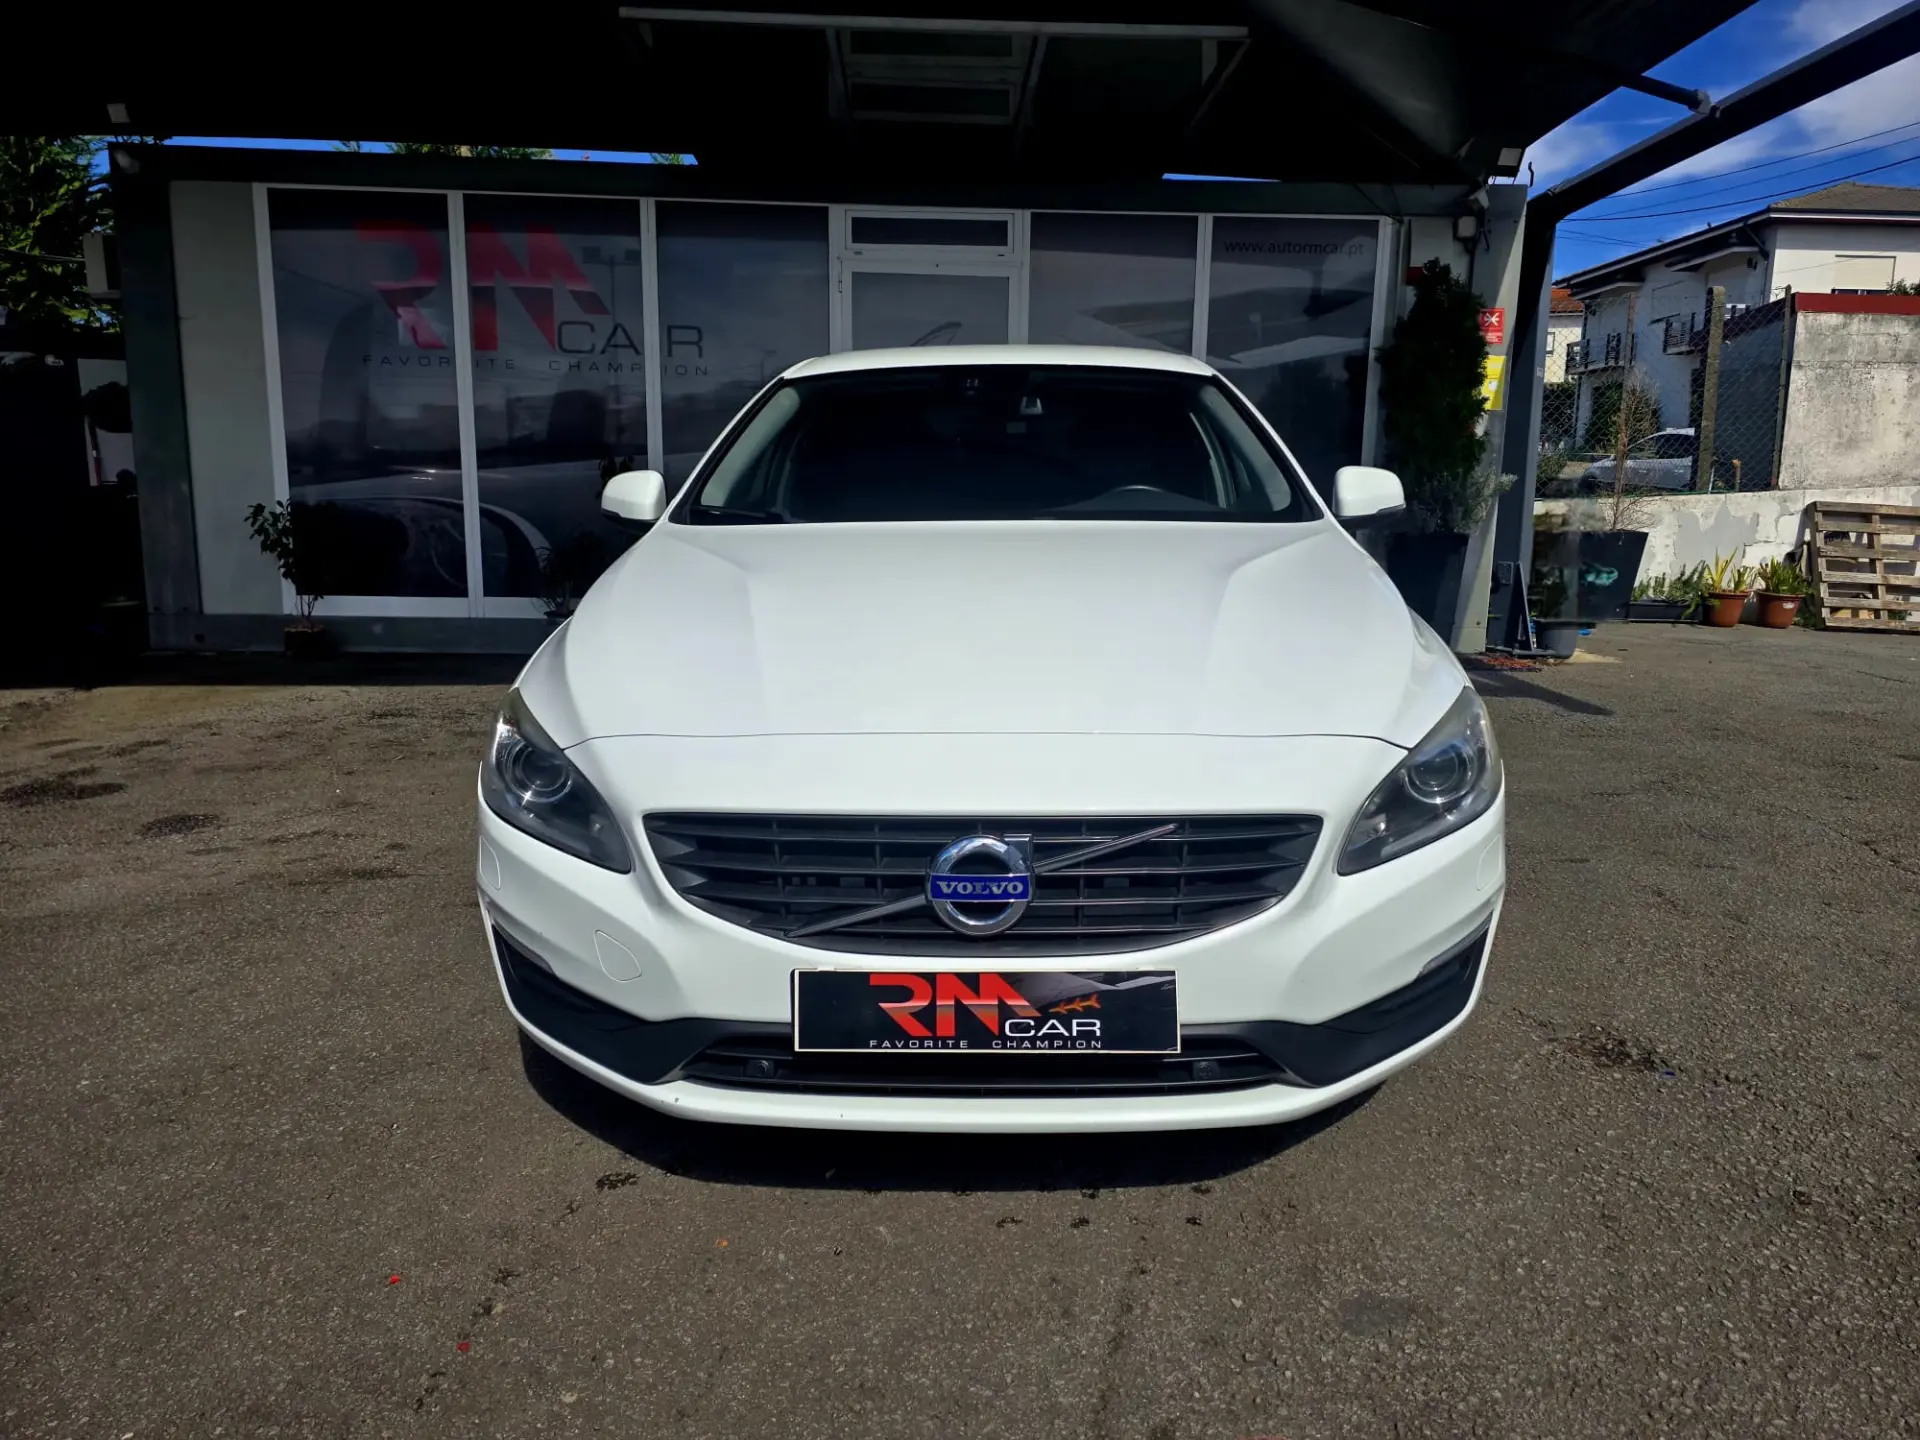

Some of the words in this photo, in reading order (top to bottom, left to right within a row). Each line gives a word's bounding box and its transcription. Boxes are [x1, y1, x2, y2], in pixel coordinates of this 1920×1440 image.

[1224, 240, 1364, 258] www.autormcar.pt
[355, 217, 612, 352] RM
[557, 320, 704, 359] CAR
[363, 354, 516, 370] FAVORITE
[548, 358, 709, 377] CHAMPION
[936, 881, 1024, 895] VOLVO
[869, 972, 1042, 1037] RM
[1004, 1019, 1101, 1037] CAR
[869, 1040, 970, 1049] FAVORITE
[992, 1040, 1101, 1049] CHAMPION
